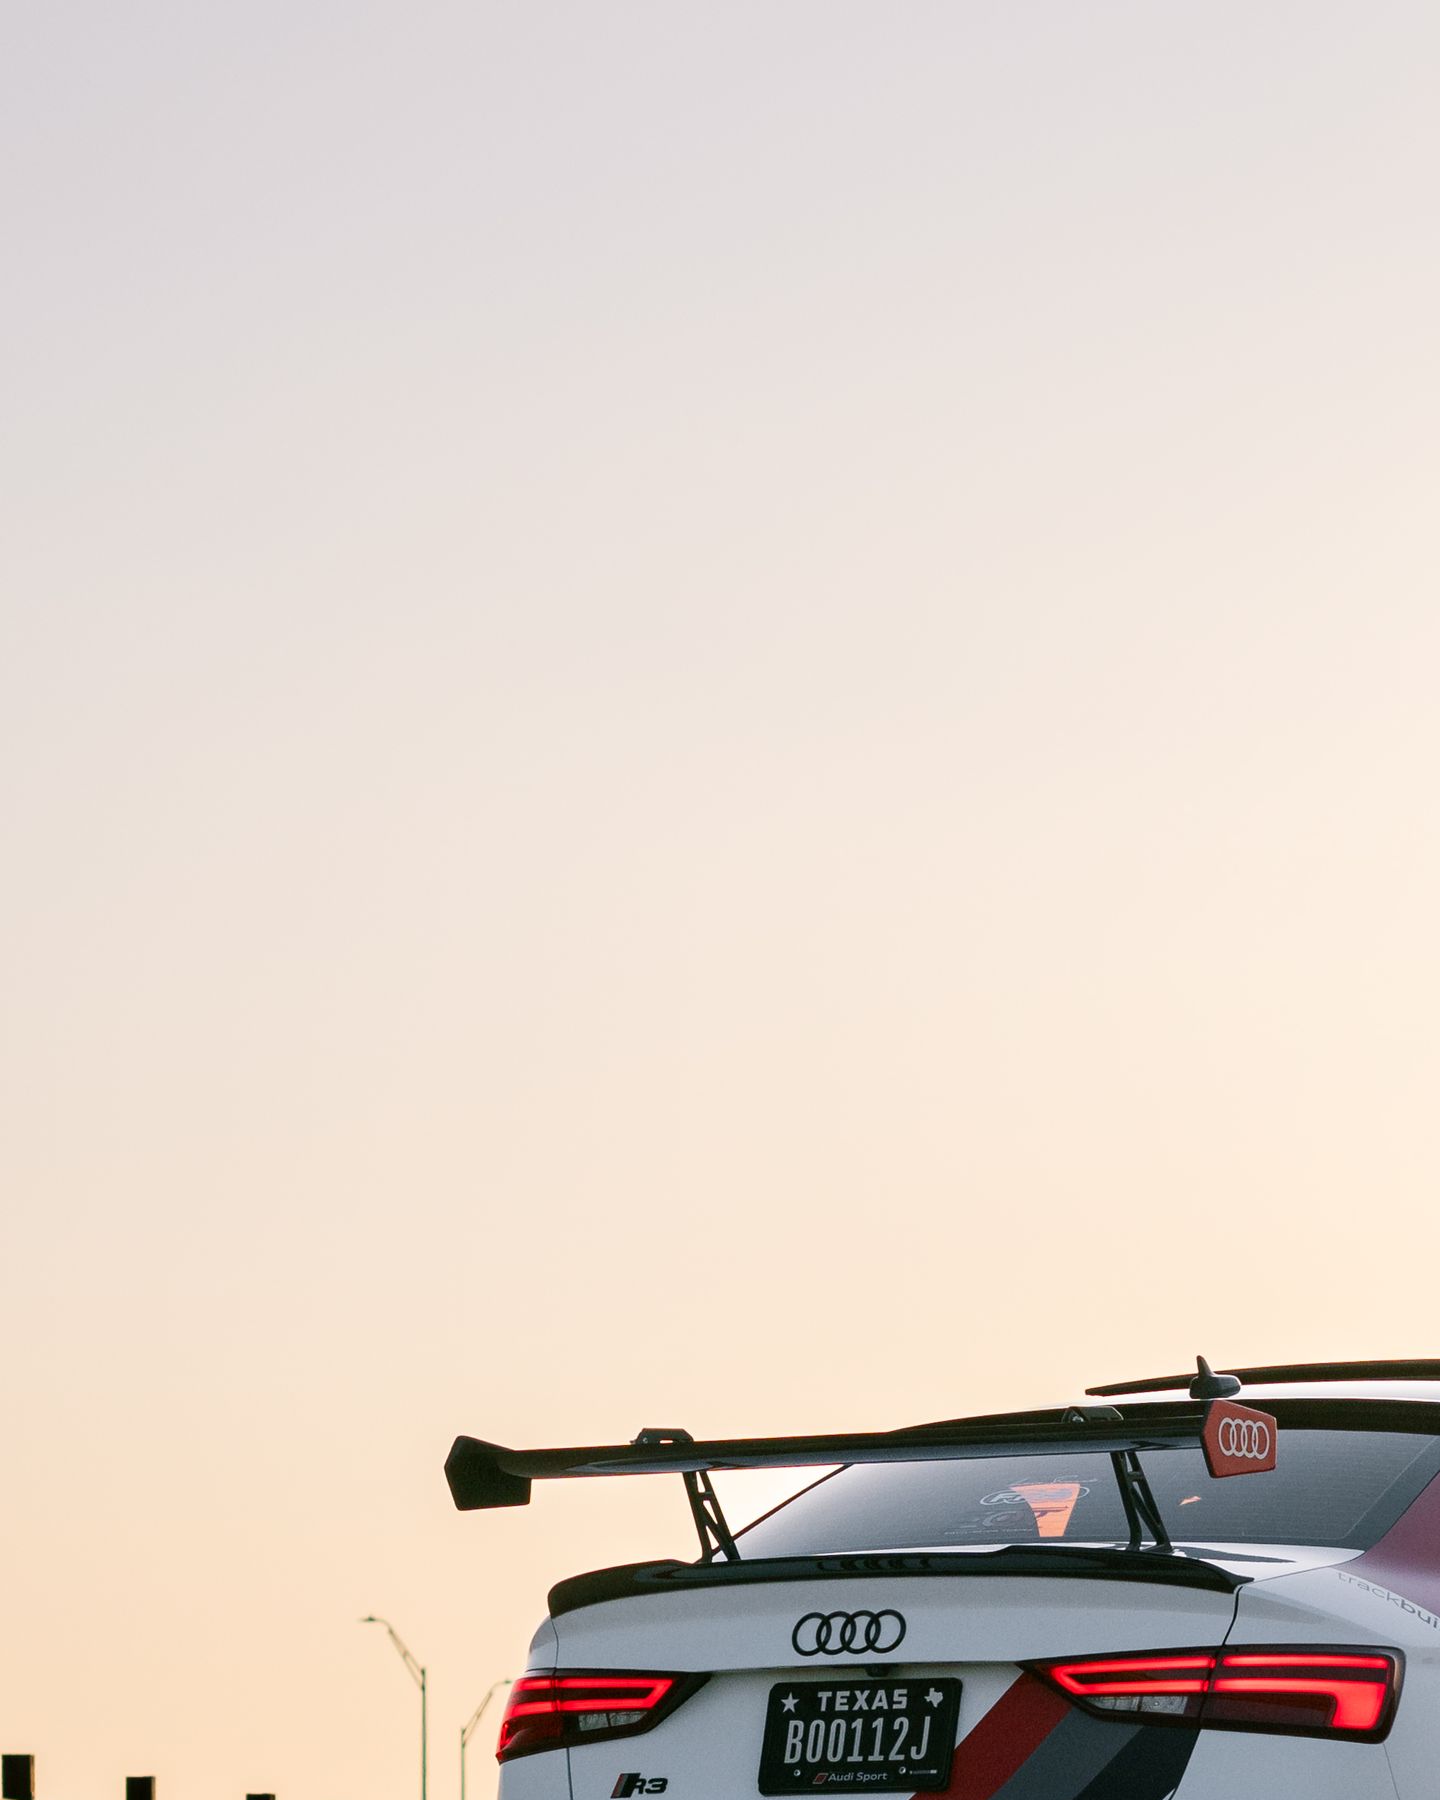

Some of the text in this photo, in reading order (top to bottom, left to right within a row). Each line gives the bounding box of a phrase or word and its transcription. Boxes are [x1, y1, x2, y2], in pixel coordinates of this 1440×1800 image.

[817, 1689, 908, 1712] TEXAS
[828, 1771, 888, 1784] Audi Sport
